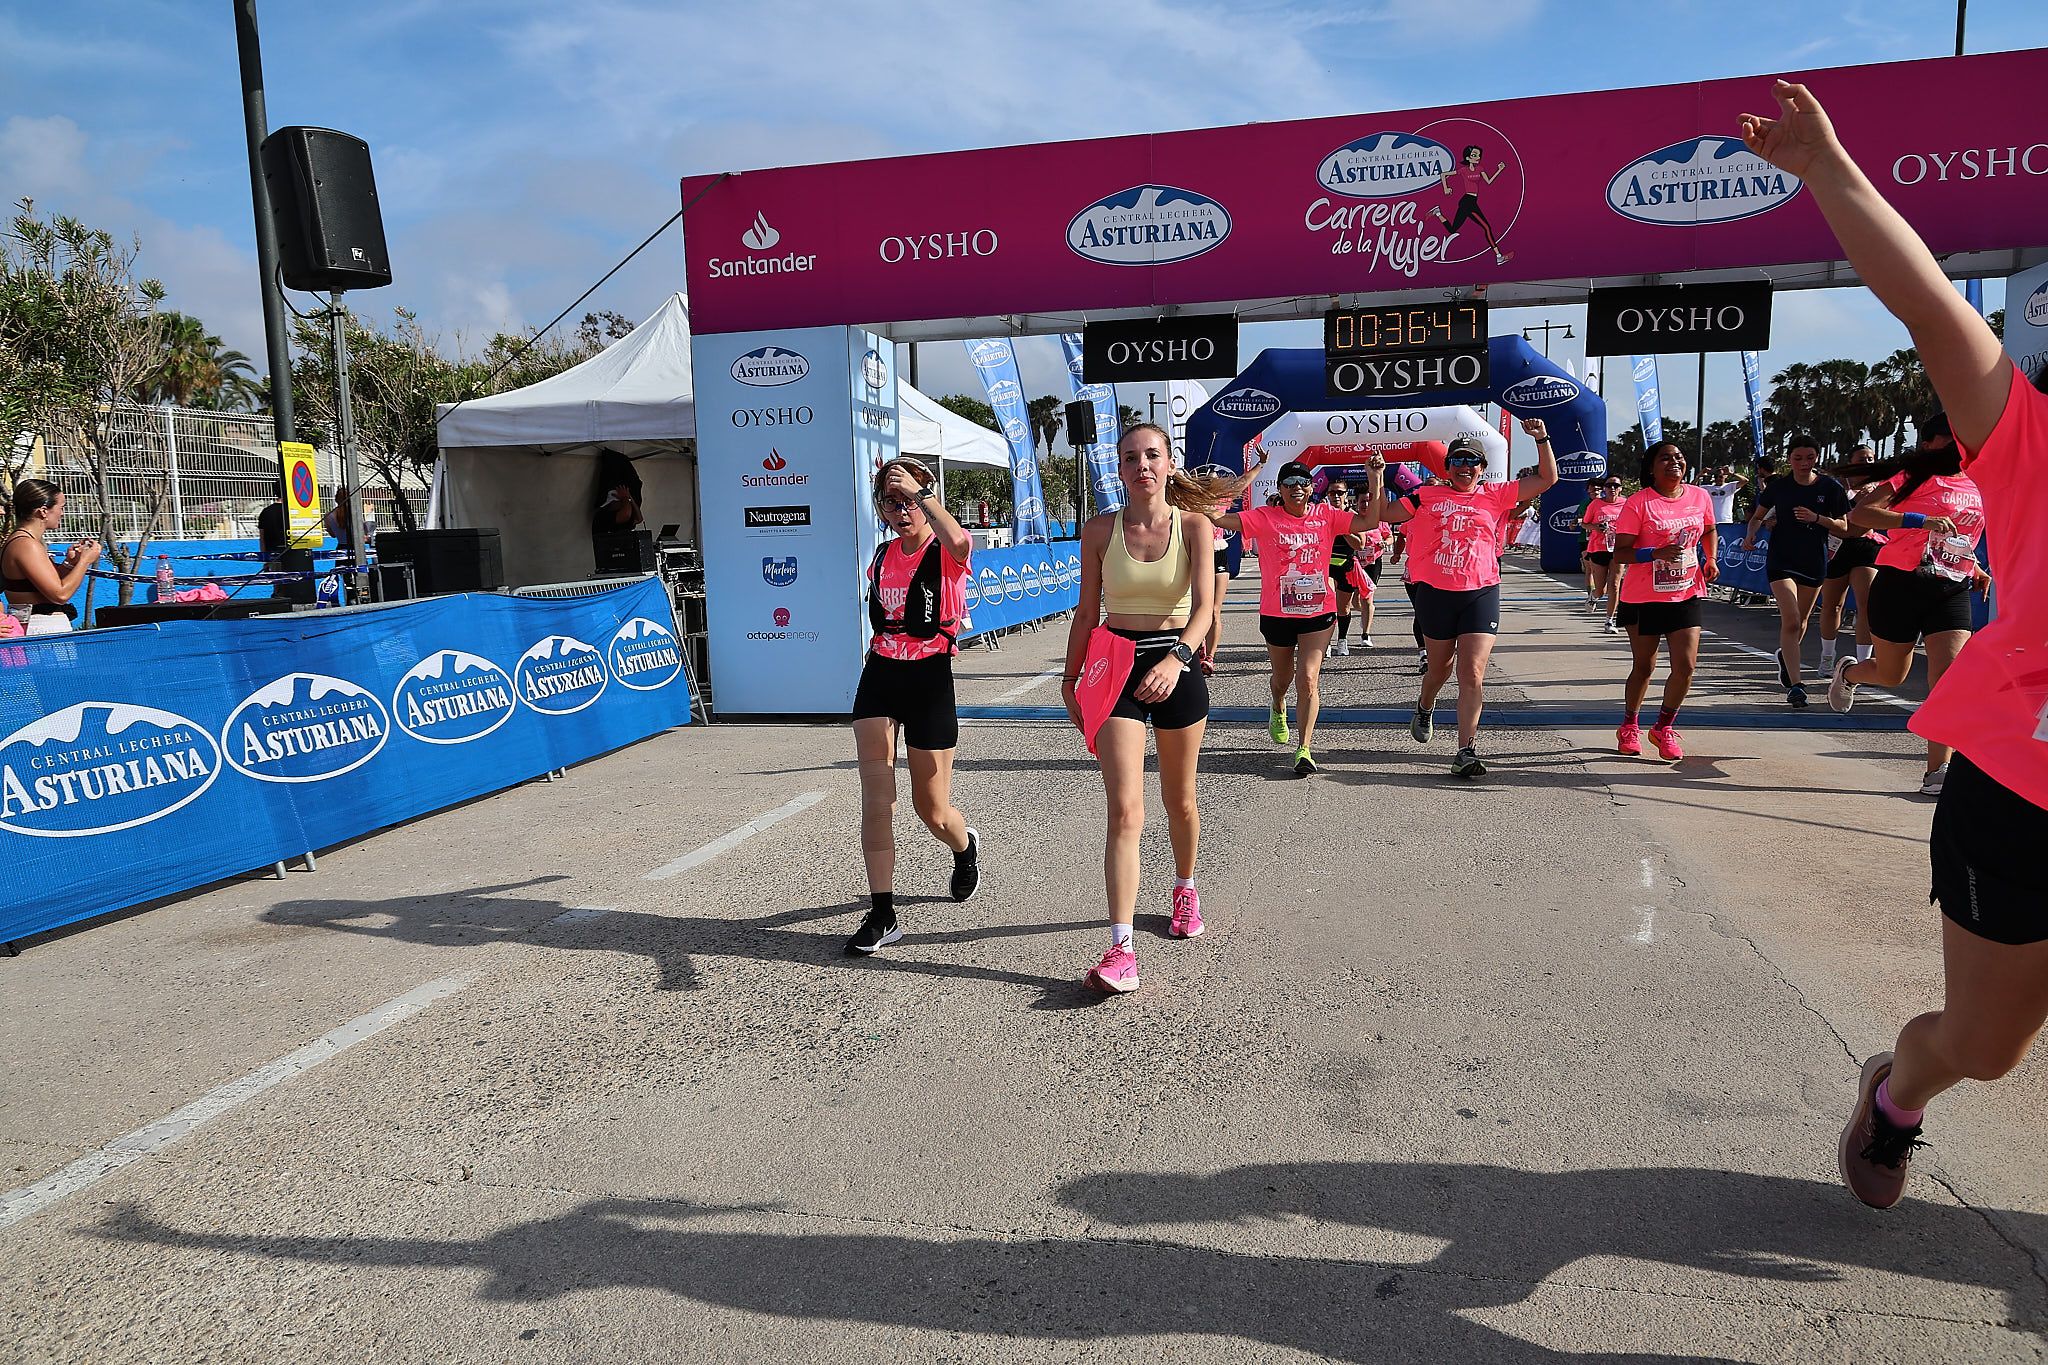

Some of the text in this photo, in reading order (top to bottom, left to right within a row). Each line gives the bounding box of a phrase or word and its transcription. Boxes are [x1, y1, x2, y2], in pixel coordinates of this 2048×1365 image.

[1348, 150, 1440, 164] CENTRAL LECHERA
[1892, 144, 2048, 185] OYSHO
[1326, 159, 1444, 185] ASTURIANA
[1651, 167, 1713, 181] CENTRAL
[1621, 174, 1788, 208] ASTURIANA
[1103, 208, 1213, 225] CENTRAL LECHERA
[1304, 197, 1418, 232] Carrera
[880, 230, 998, 263] OYSHO
[1078, 218, 1219, 250] ASTURIANA
[1332, 221, 1461, 278] de la Mujer
[708, 252, 817, 279] Santander
[1336, 308, 1476, 349] 00:36:47
[1616, 305, 1745, 333] OYSHO
[1107, 337, 1215, 365] OYSHO
[737, 363, 804, 378] ASTURIANA
[1333, 355, 1481, 392] OYSHO
[1216, 401, 1276, 413] ASTURIANA
[1509, 387, 1576, 403] ASTURIANA
[731, 406, 814, 428] OYSHO
[862, 406, 890, 429] OYSHO
[1326, 411, 1428, 435] OYSHO
[1267, 439, 1297, 448] OYSHO
[1324, 442, 1412, 455] Sports Santander
[742, 473, 809, 487] Santander
[1255, 480, 1276, 488] OYSH
[1480, 471, 1503, 480] YSHO
[1941, 491, 1982, 507] CARRER
[749, 510, 807, 525] Neutrogena
[1279, 532, 1320, 545] CARRERA
[1433, 552, 1465, 568] MUJER
[1295, 593, 1314, 601] 016
[617, 647, 679, 678] ASTURIANA
[420, 673, 499, 695] CENTRAL LECHERA
[525, 665, 604, 702] ASTURIANA
[263, 699, 369, 727] CENTRAL LECHERA
[407, 686, 511, 729] ASTURIANA
[31, 731, 192, 770] CENTRAL LECHERA
[243, 712, 382, 767] ASTURIANA
[0, 748, 210, 819] ASTURIANA
[1966, 865, 1980, 920] SALOMON
